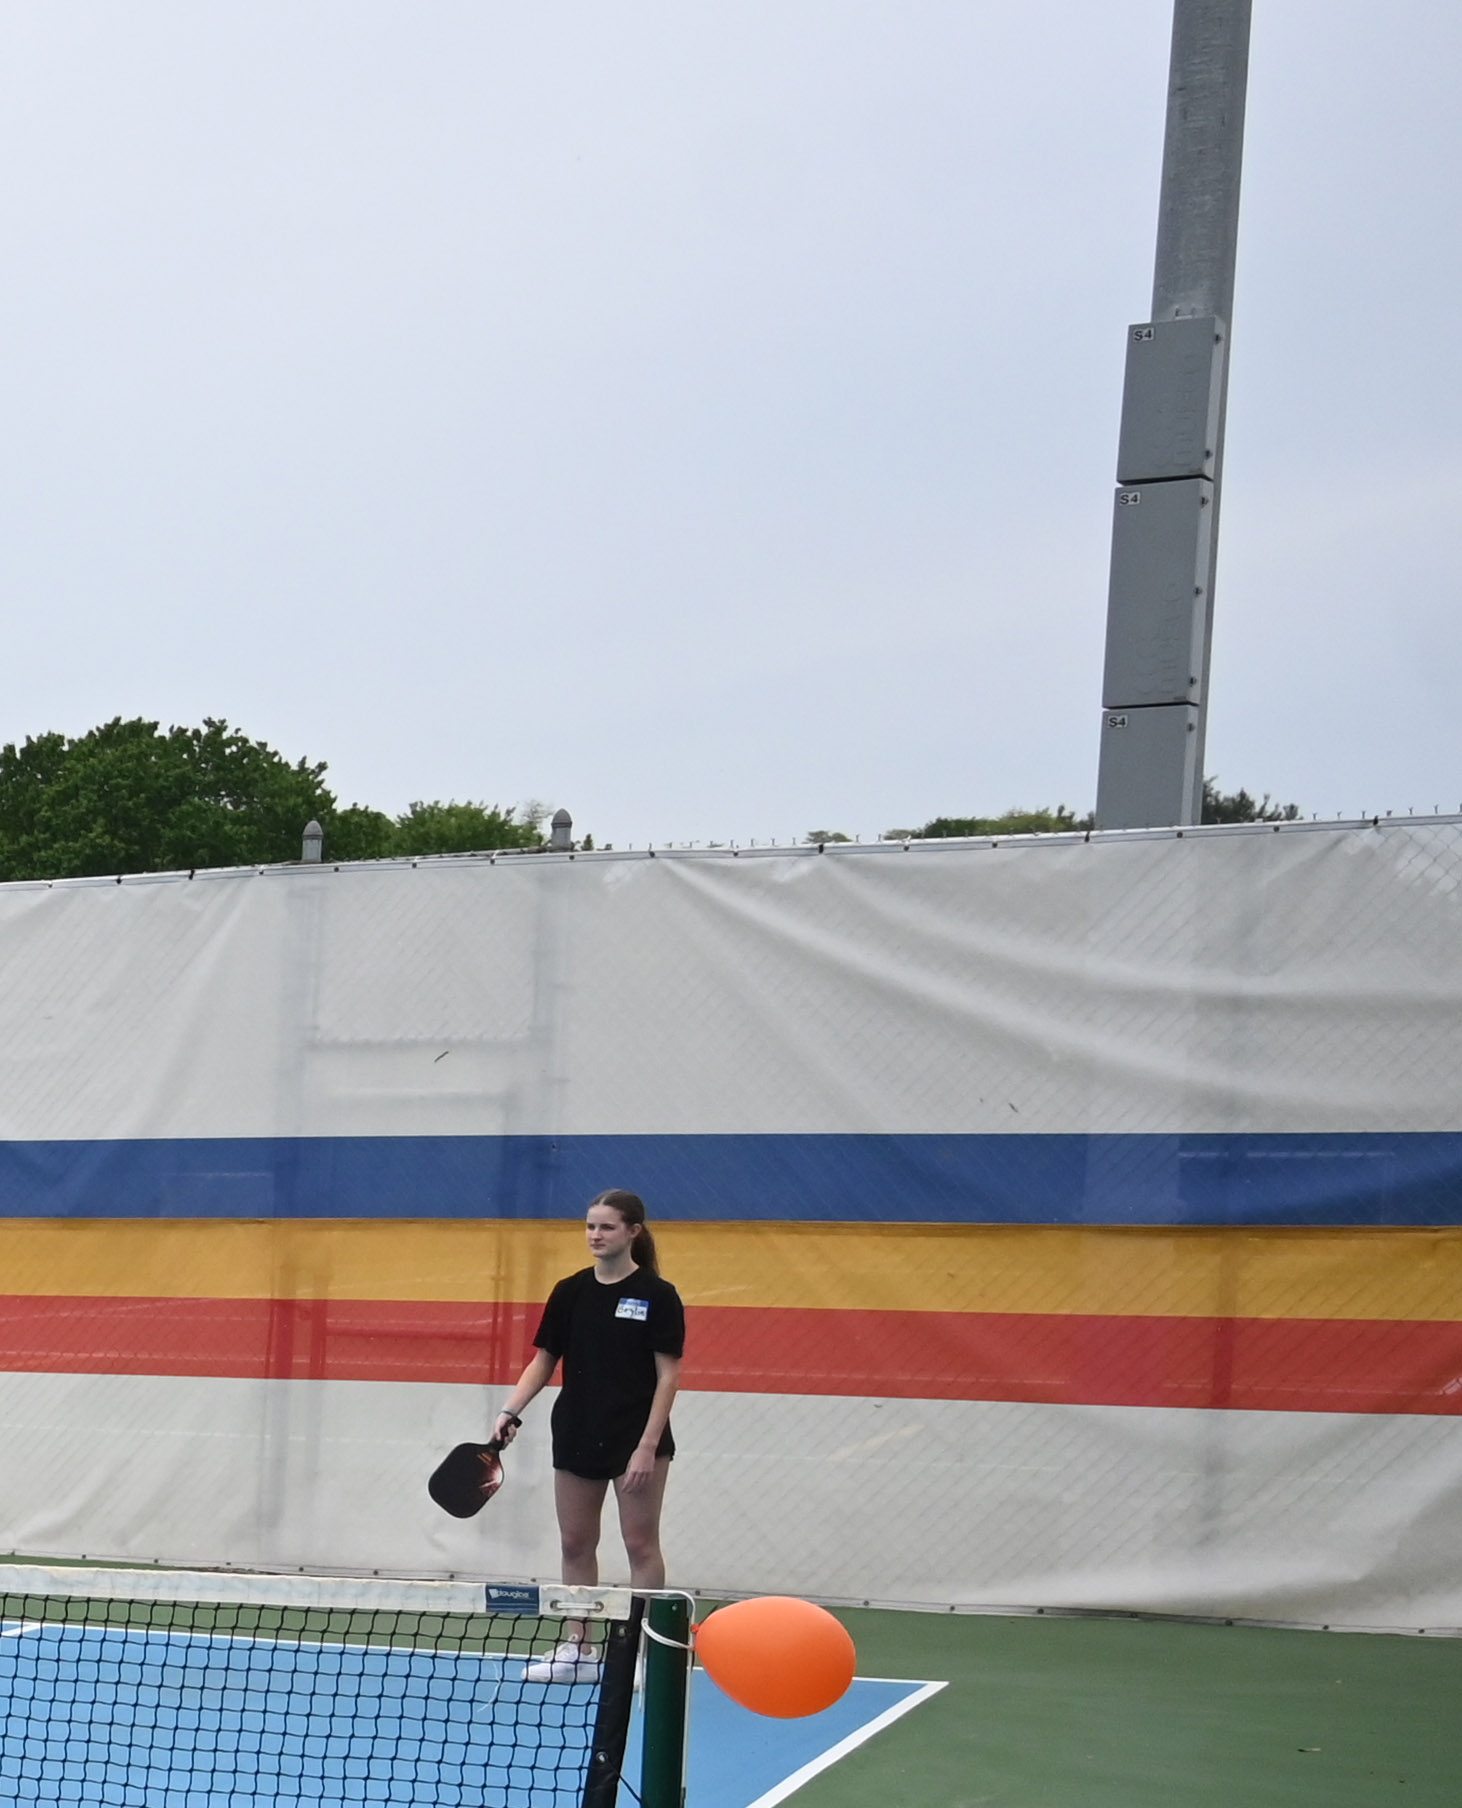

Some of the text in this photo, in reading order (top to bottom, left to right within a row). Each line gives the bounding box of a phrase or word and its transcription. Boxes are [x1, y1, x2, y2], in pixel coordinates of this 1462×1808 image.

[1134, 329, 1152, 341] S4
[1120, 494, 1138, 504] S4
[1109, 717, 1126, 728] S4
